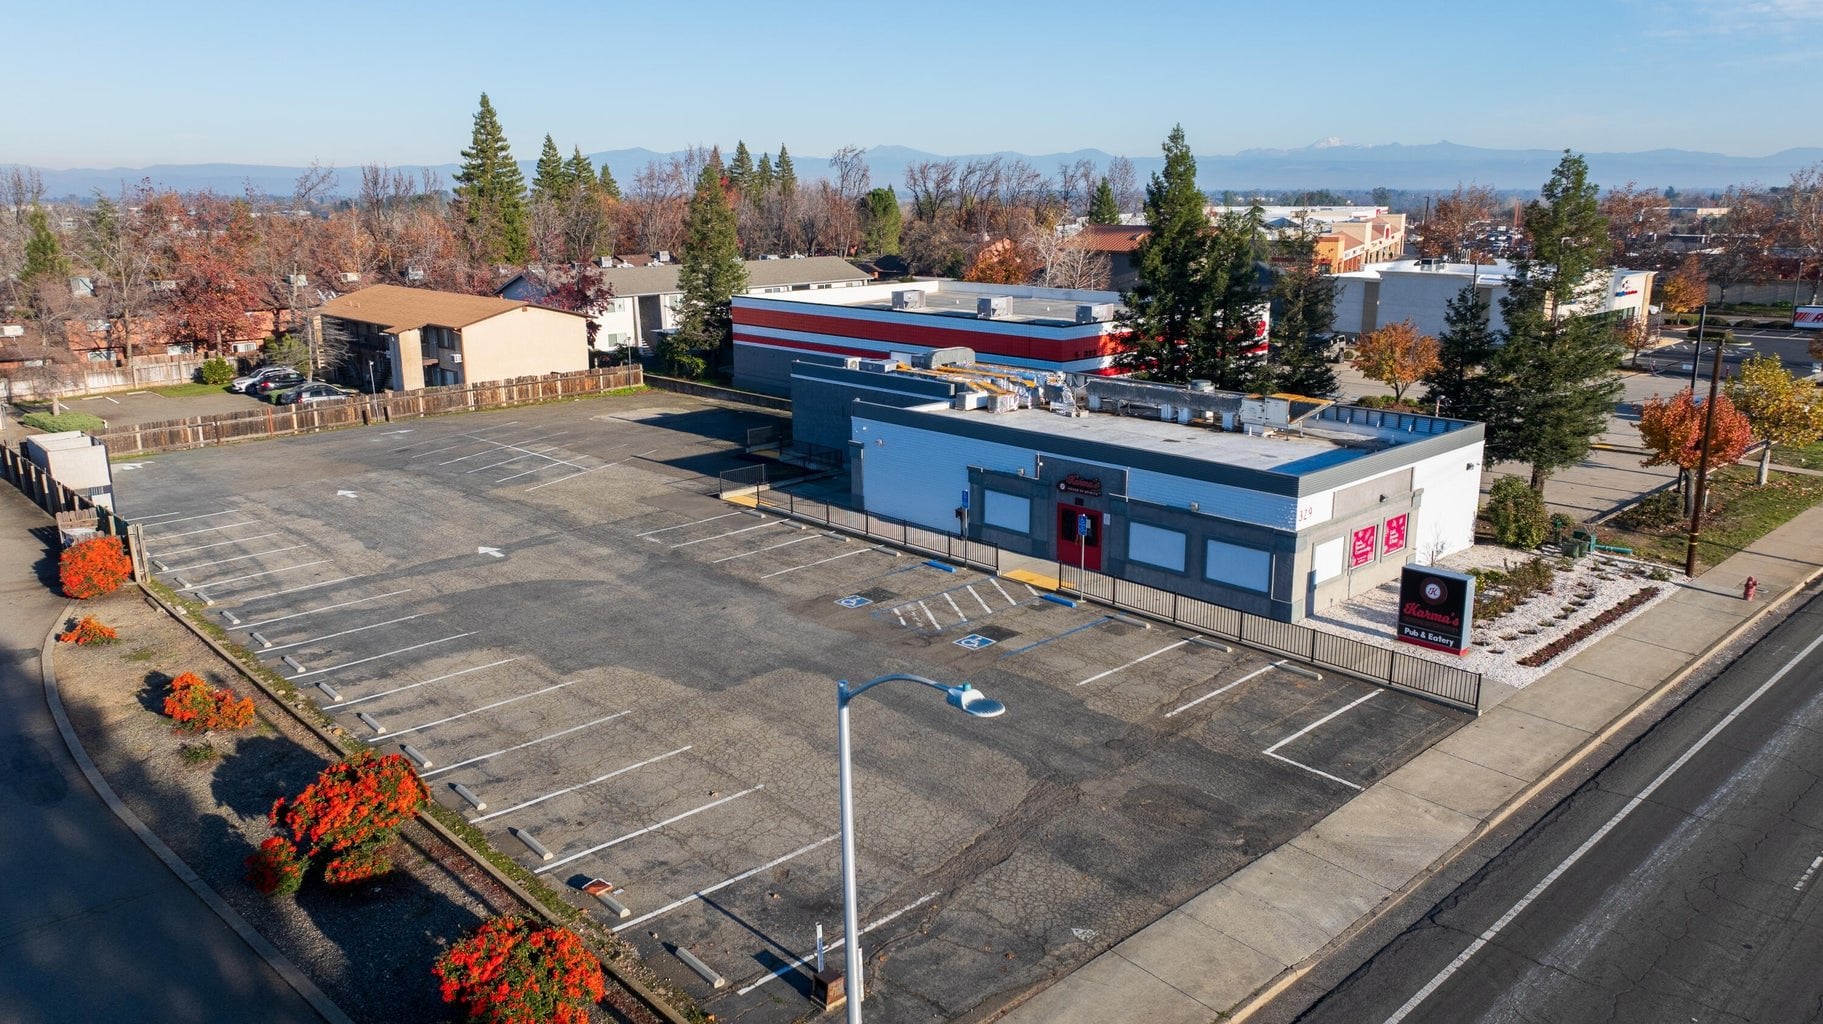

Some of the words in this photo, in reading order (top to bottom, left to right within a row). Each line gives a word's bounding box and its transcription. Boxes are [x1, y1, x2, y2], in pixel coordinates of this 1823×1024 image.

[1298, 506, 1313, 522] 329
[1403, 602, 1459, 626] Karma's
[1404, 627, 1419, 637] Pub
[1420, 631, 1426, 639] &
[1428, 632, 1454, 647] Eatery
